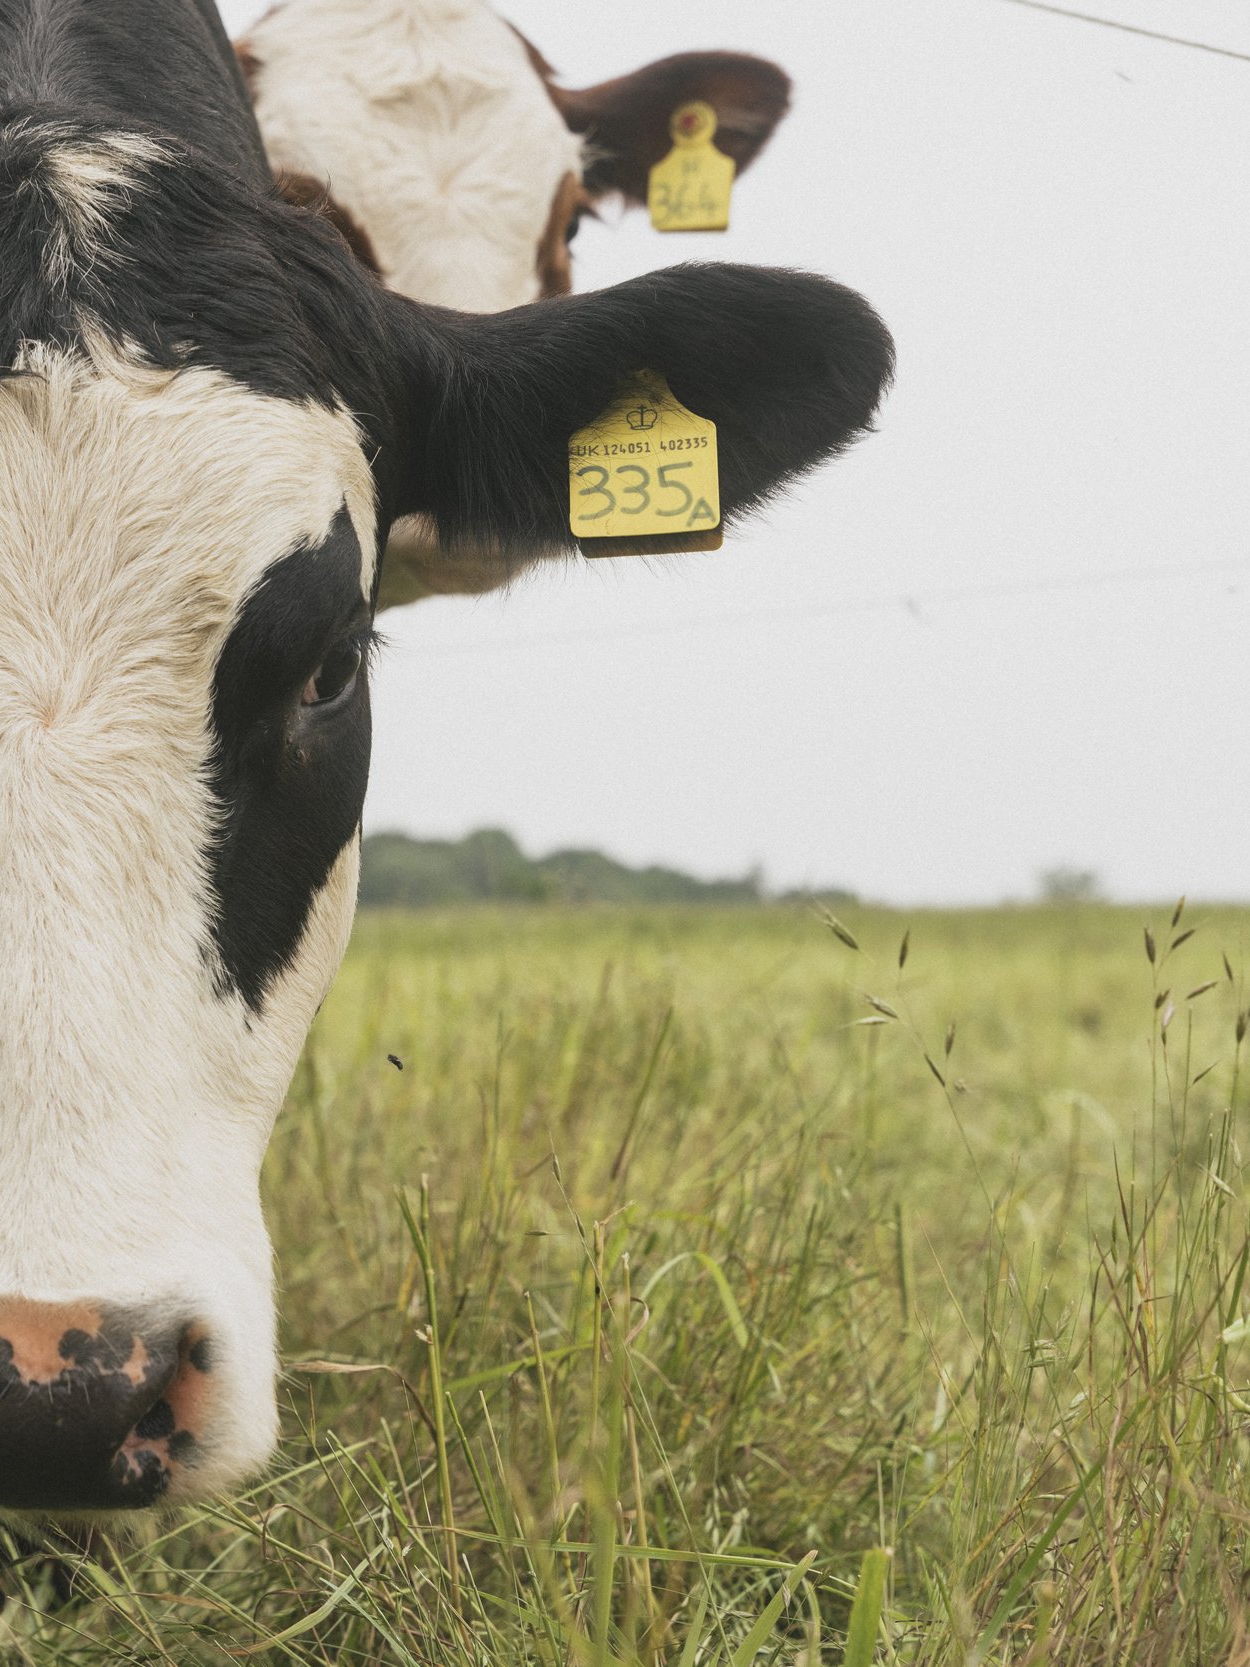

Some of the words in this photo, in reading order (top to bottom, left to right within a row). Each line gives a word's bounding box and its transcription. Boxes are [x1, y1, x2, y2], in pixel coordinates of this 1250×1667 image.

[576, 444, 600, 456] UK
[603, 442, 651, 456] 124051
[660, 436, 708, 451] 402335
